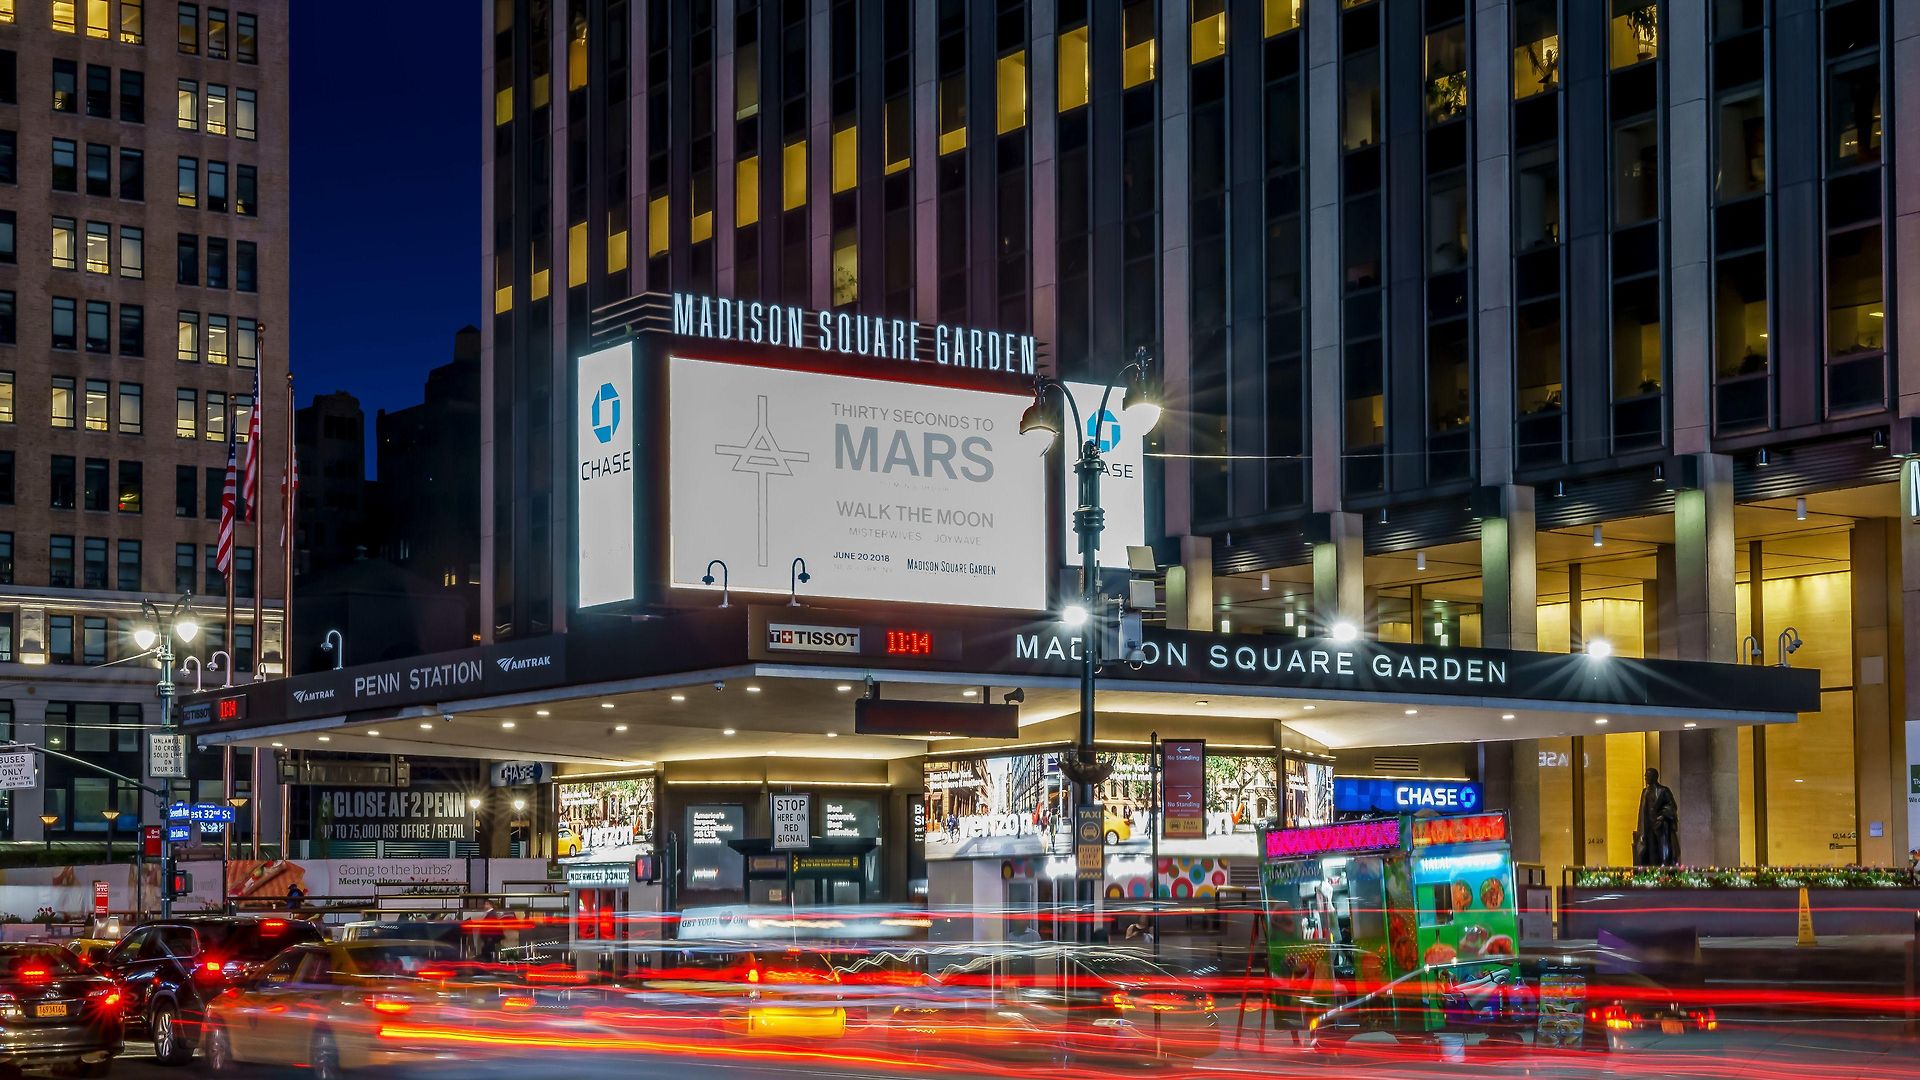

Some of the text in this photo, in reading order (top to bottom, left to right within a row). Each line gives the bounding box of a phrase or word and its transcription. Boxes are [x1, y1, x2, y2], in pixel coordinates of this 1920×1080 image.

[674, 292, 1035, 375] MADISON SQUARE GARDEN
[832, 402, 994, 432] THIRTY SECONDS TO
[834, 423, 995, 483] MARS
[581, 450, 631, 481] CHASE
[836, 500, 994, 529] WALK THE MOON
[849, 527, 923, 542] MISTERWIVES
[833, 551, 890, 562] JUNE 20 2018
[907, 558, 939, 572] MADISON
[941, 560, 967, 574] SQUARE
[969, 562, 996, 576] GARDEN
[797, 631, 858, 647] TISSOT
[888, 631, 930, 654] 11:14
[511, 655, 551, 670] AMTRAK
[1209, 644, 1355, 675] SQUARE
[1372, 654, 1506, 683] GARDEN
[354, 659, 482, 698] PENN STATION
[304, 689, 335, 702] AMTRAK
[2, 768, 23, 776] ONLY
[388, 791, 409, 818] AF
[411, 791, 421, 818] 2
[423, 791, 465, 818] PENN
[1396, 787, 1458, 806] CHASE
[776, 799, 806, 811] STOP
[191, 809, 231, 819] est 32nd St
[777, 813, 806, 821] HERE ON
[336, 824, 347, 839] TO
[350, 824, 380, 840] 75,000
[382, 824, 399, 839] RSF
[401, 824, 430, 839] OFFICE
[437, 824, 465, 839] RETAIL
[784, 823, 799, 832] RED
[777, 834, 806, 843] SIGNAL
[339, 864, 452, 877] Going to the burbs?
